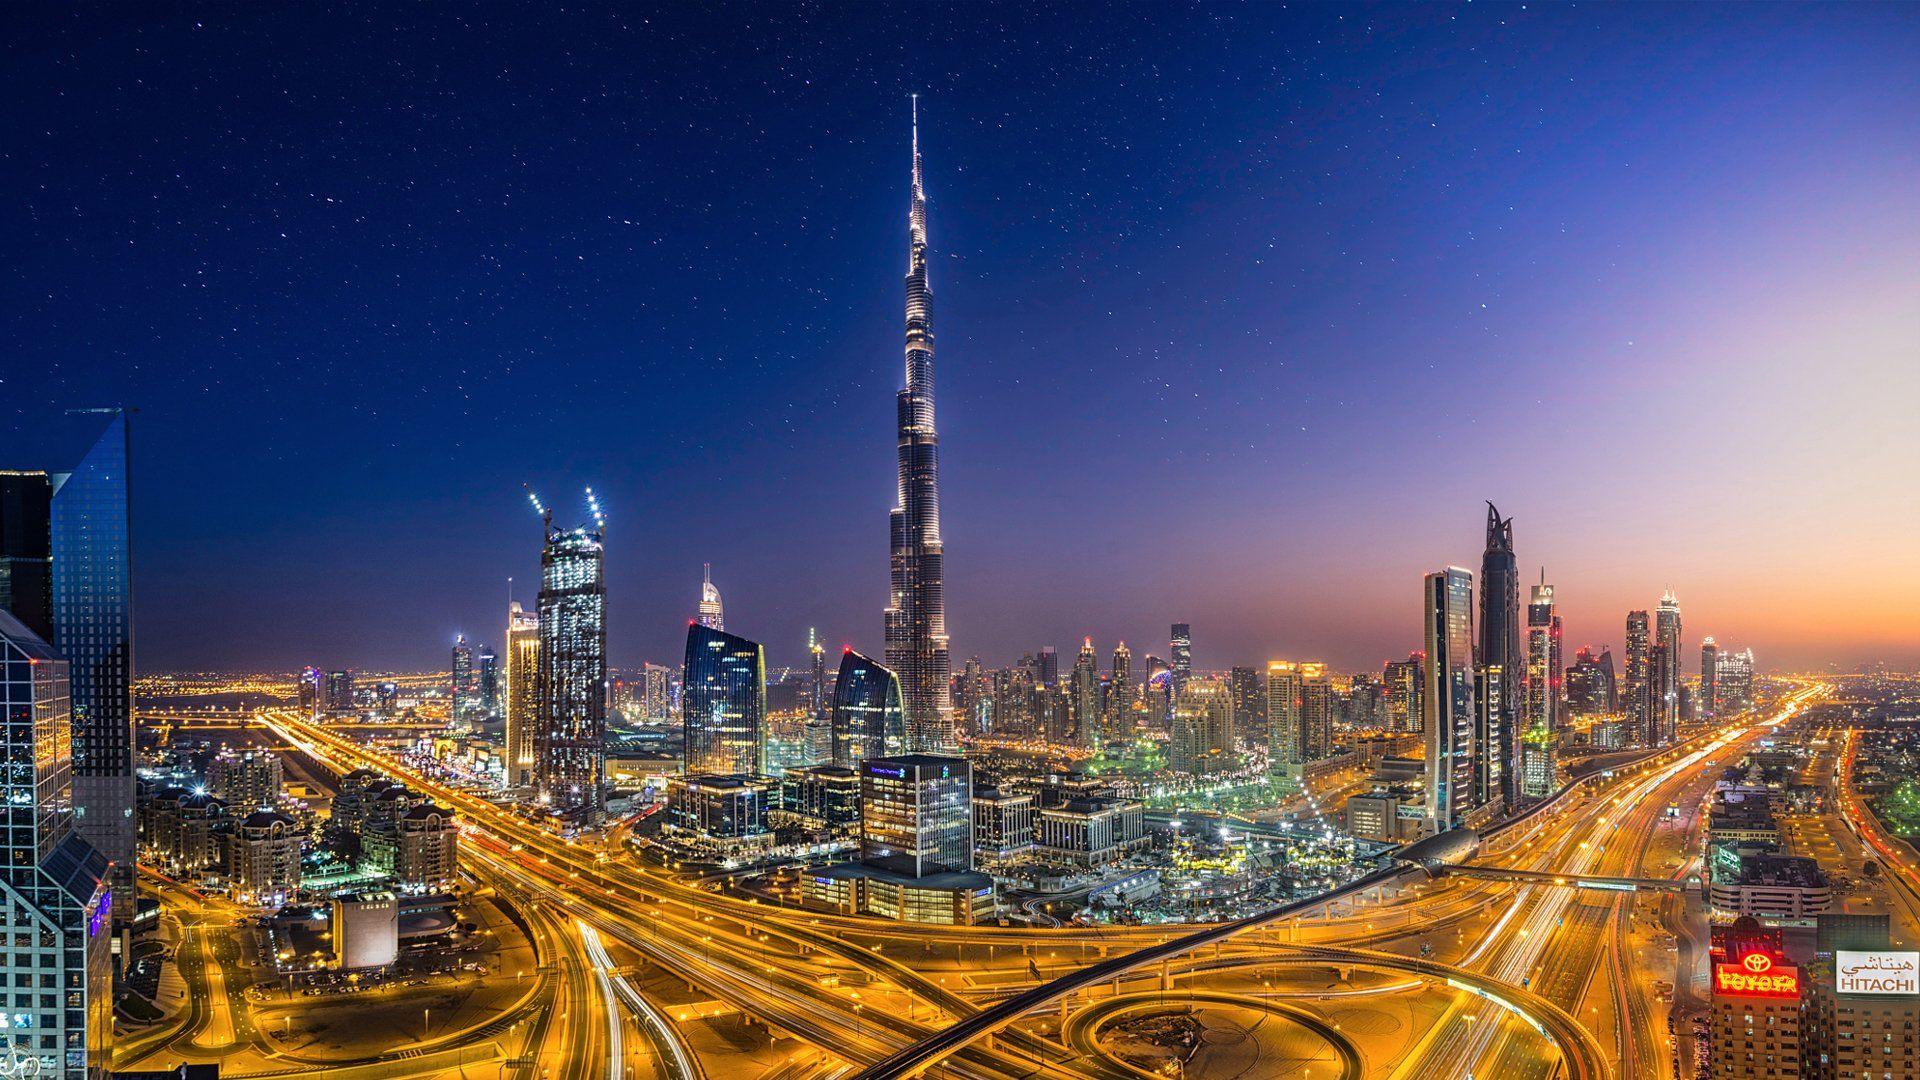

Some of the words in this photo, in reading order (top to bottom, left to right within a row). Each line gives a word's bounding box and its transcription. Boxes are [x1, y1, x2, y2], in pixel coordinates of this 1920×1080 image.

[1841, 956, 1914, 977] هيتاشي
[1718, 973, 1797, 993] TOYOTA
[1841, 978, 1914, 992] HITACHI
